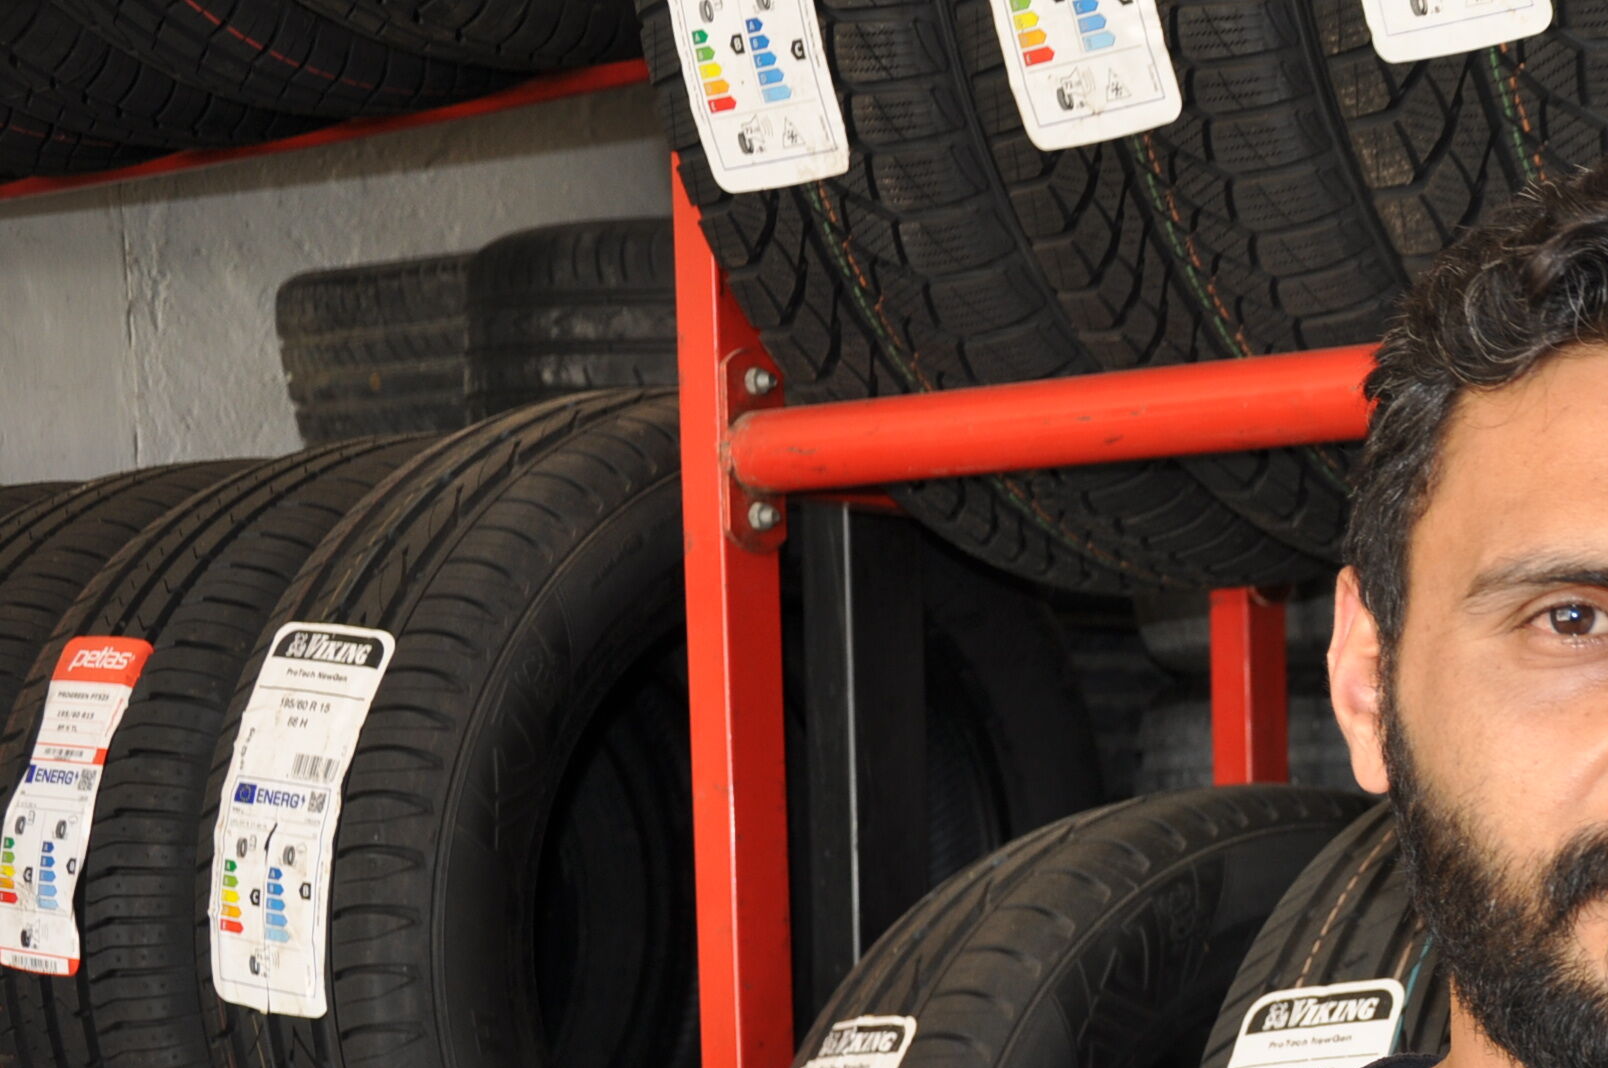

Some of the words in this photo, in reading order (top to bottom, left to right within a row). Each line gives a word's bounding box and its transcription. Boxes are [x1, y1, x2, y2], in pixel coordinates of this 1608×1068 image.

[67, 646, 133, 672] petlas
[304, 633, 373, 665] VIKING
[309, 700, 318, 712] R
[299, 718, 309, 728] H
[34, 768, 75, 785] ENERG
[256, 788, 300, 809] ENERG
[1288, 997, 1380, 1028] VIKING
